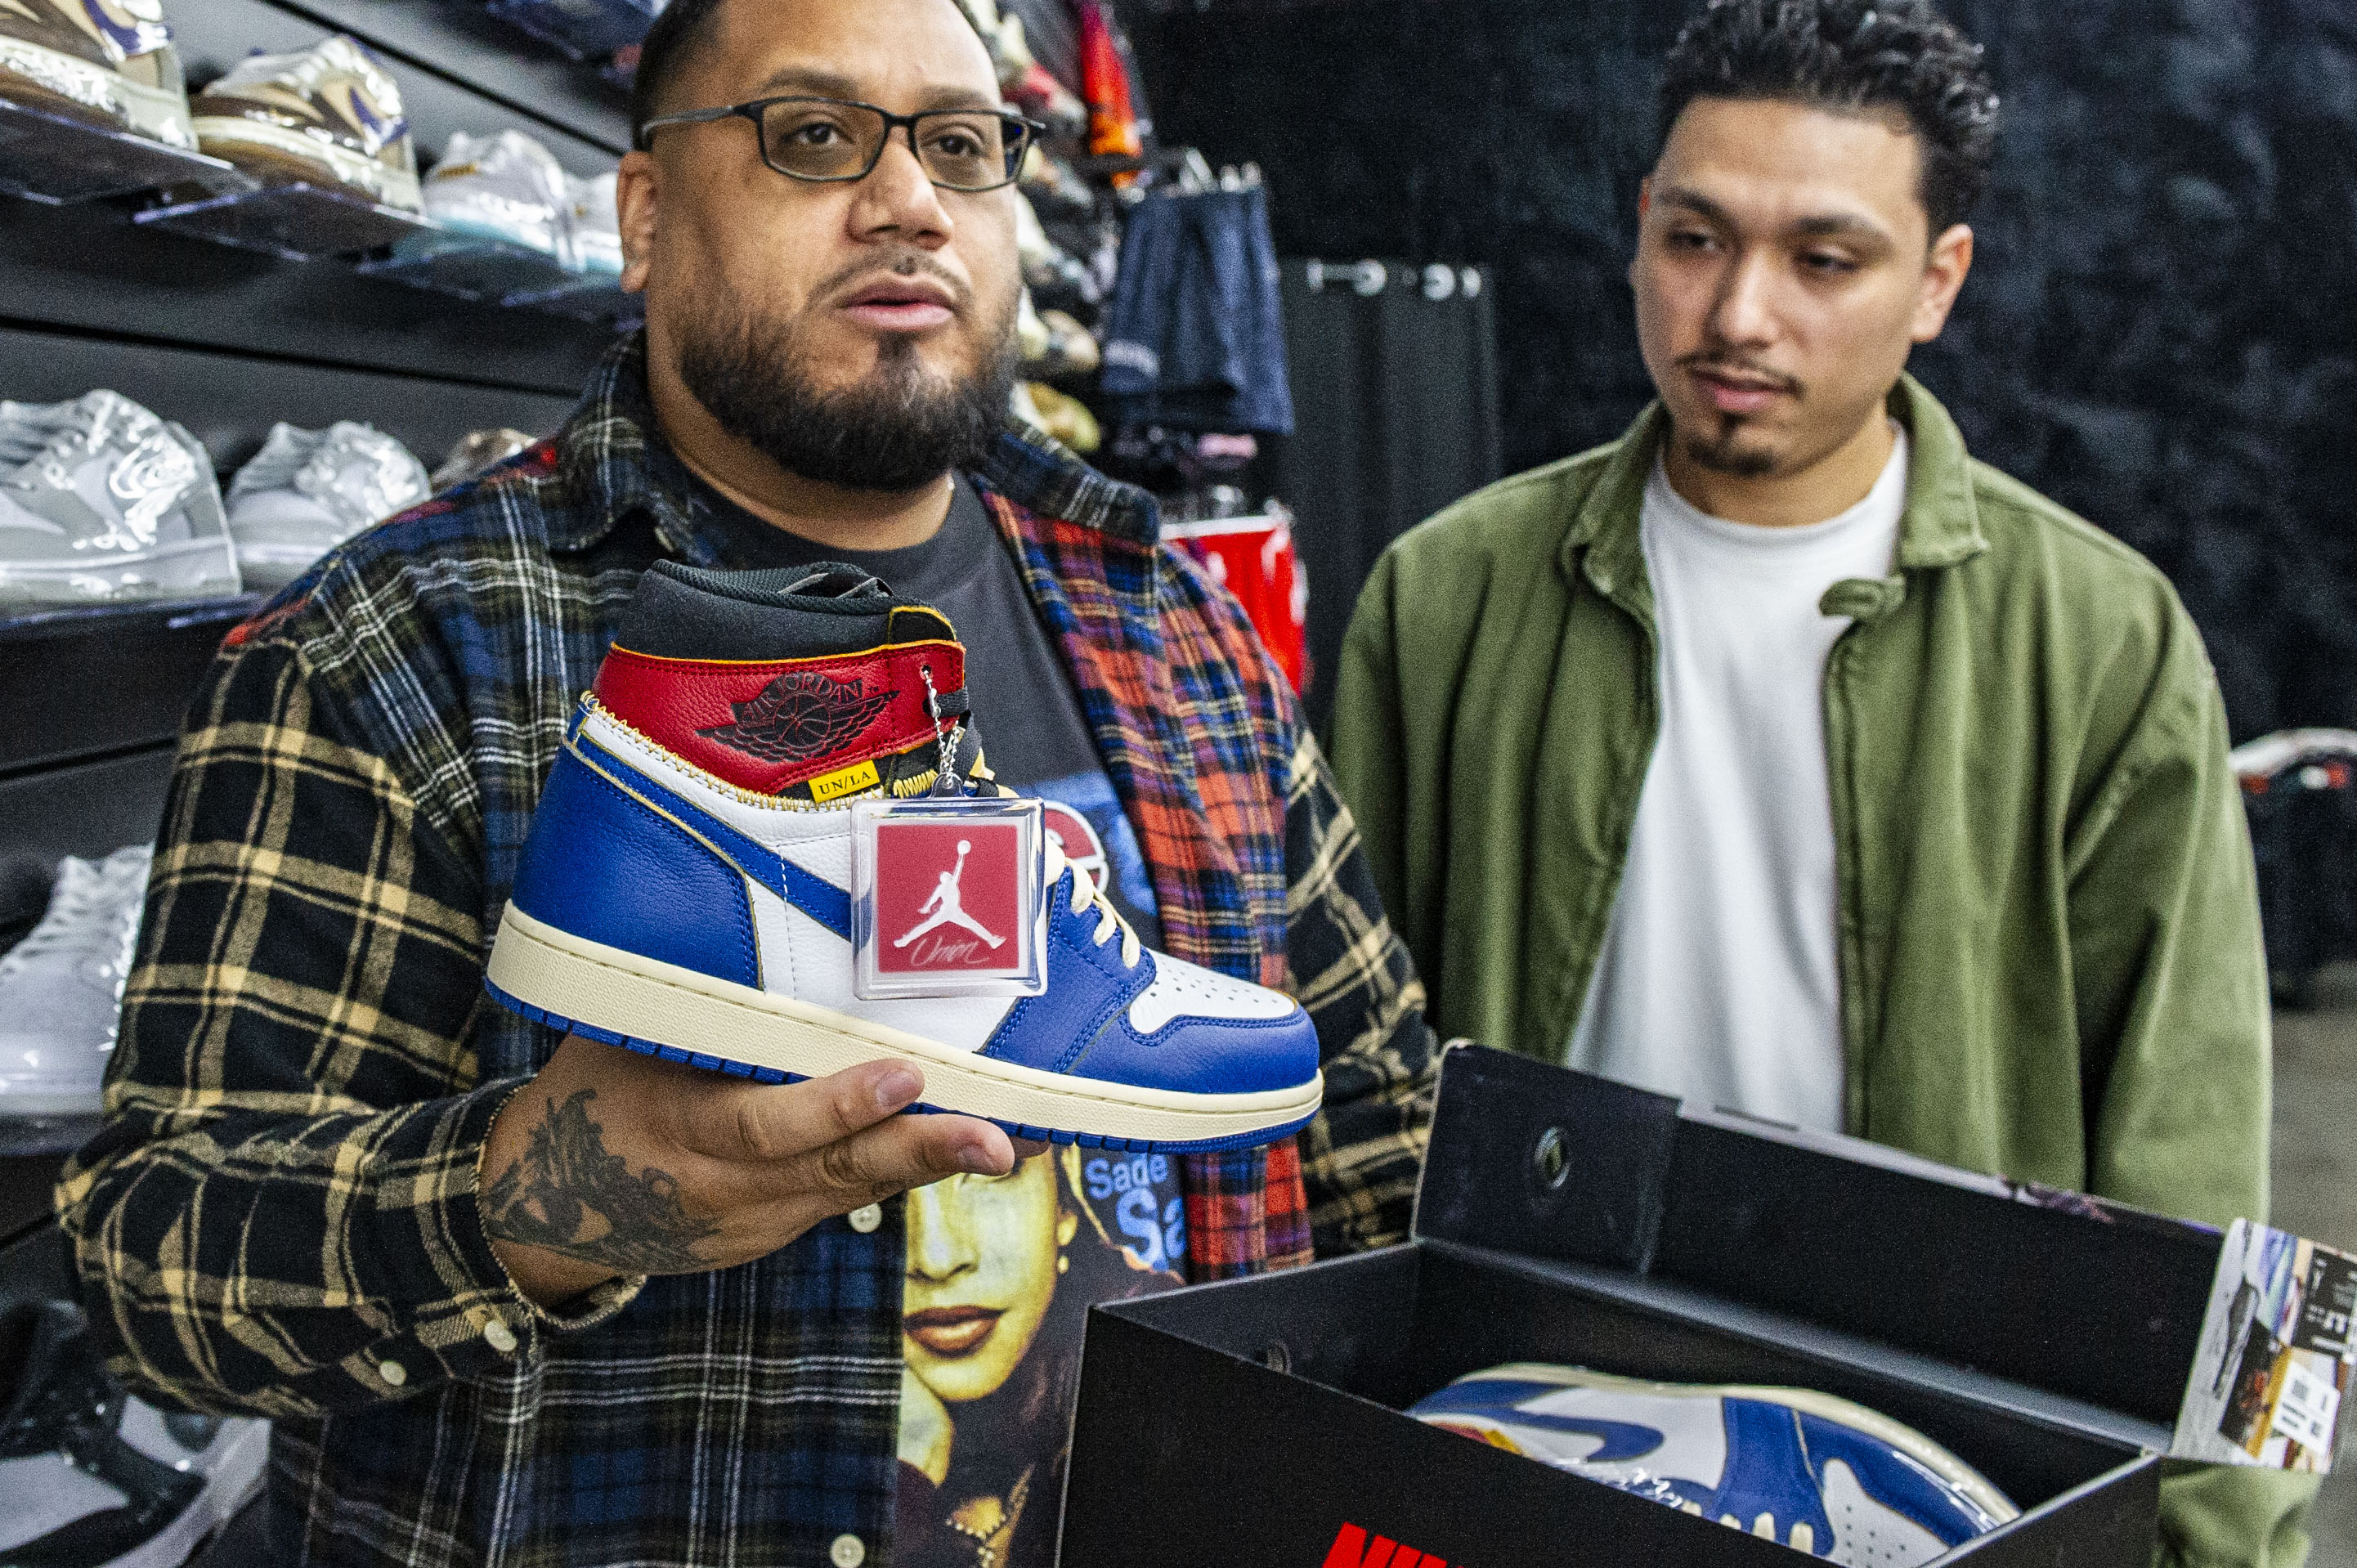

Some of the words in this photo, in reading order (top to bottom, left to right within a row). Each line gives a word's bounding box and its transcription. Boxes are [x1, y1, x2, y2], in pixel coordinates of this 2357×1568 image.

[742, 691, 778, 720] AIR
[775, 672, 862, 705] JORDAN
[818, 771, 872, 795] UN/LA
[1085, 1151, 1168, 1200] Sade
